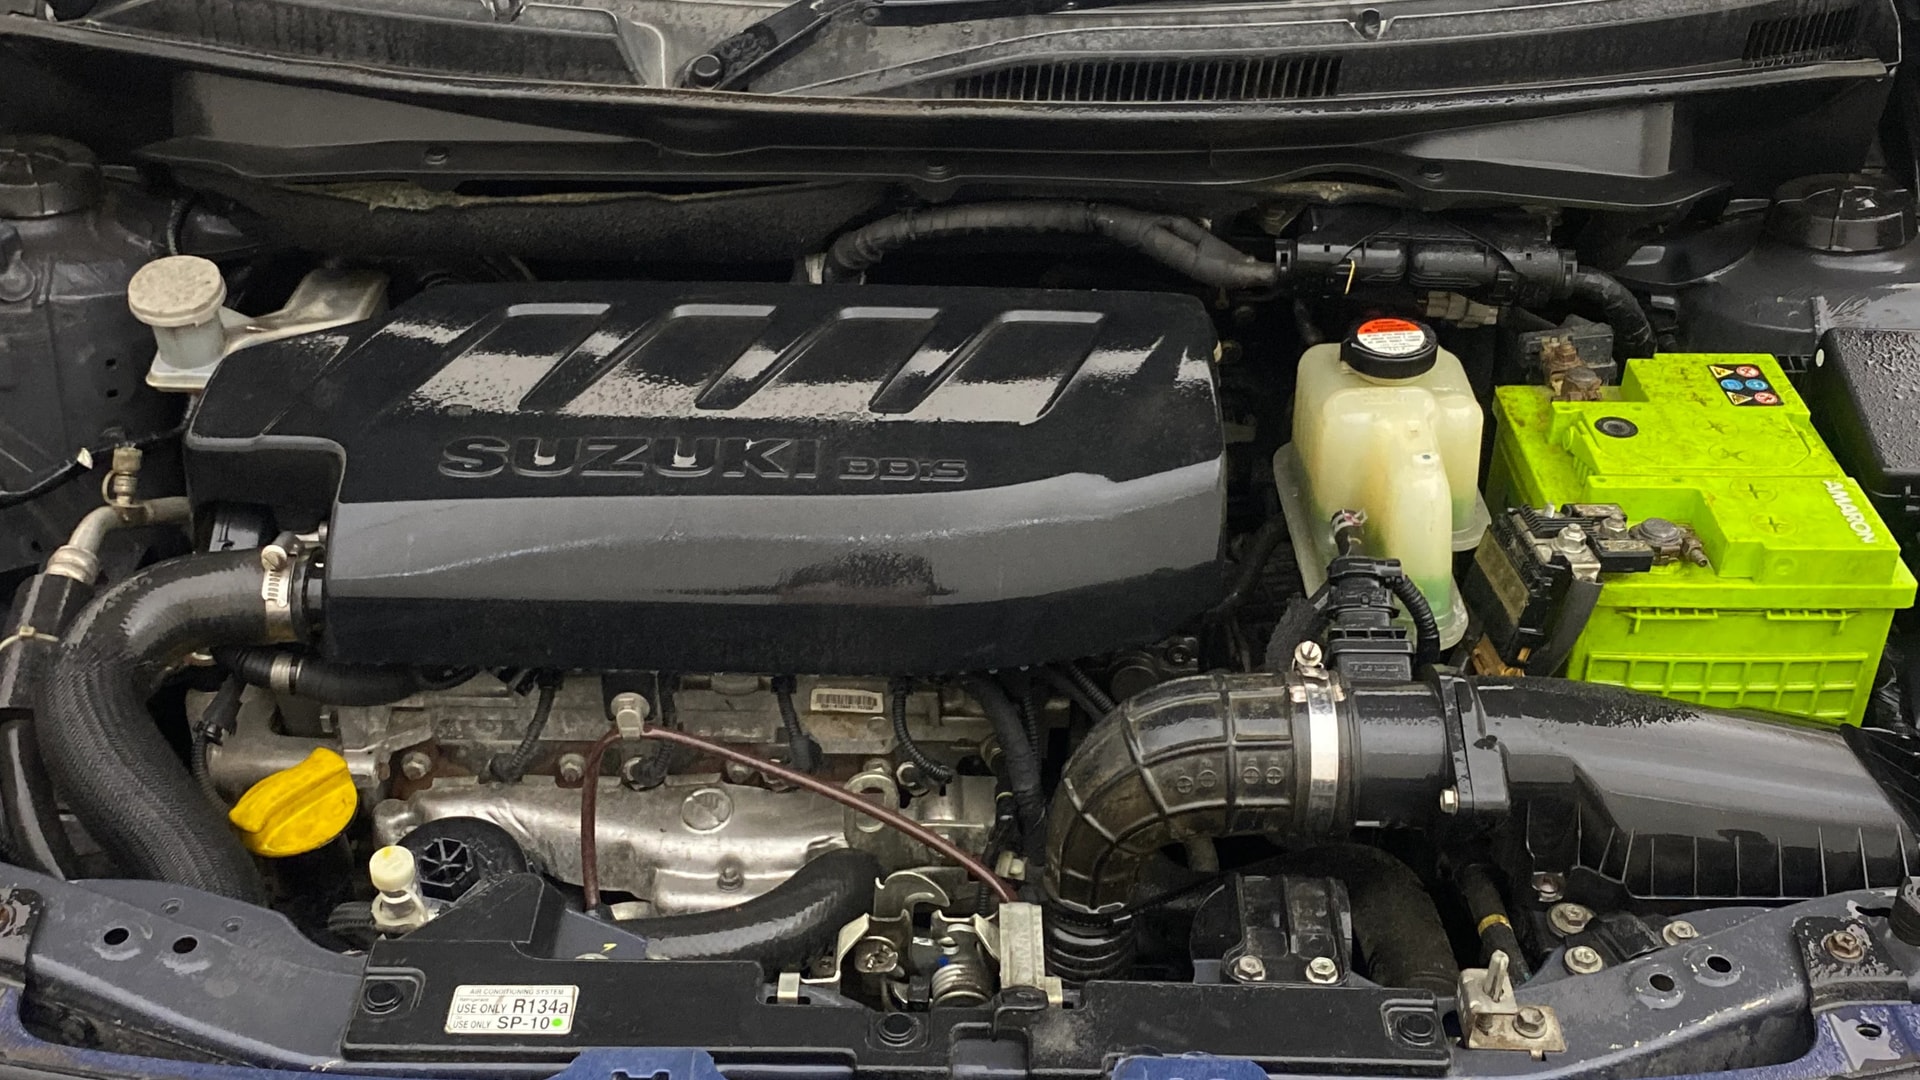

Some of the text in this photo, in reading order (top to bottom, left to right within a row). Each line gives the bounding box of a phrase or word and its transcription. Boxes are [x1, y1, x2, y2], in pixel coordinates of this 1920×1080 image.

[437, 435, 820, 478] SUZUKI
[1822, 480, 1878, 544] AMARON
[457, 998, 569, 1014] USE ONLY R134a
[453, 1015, 550, 1030] USE ONLY SP-10
